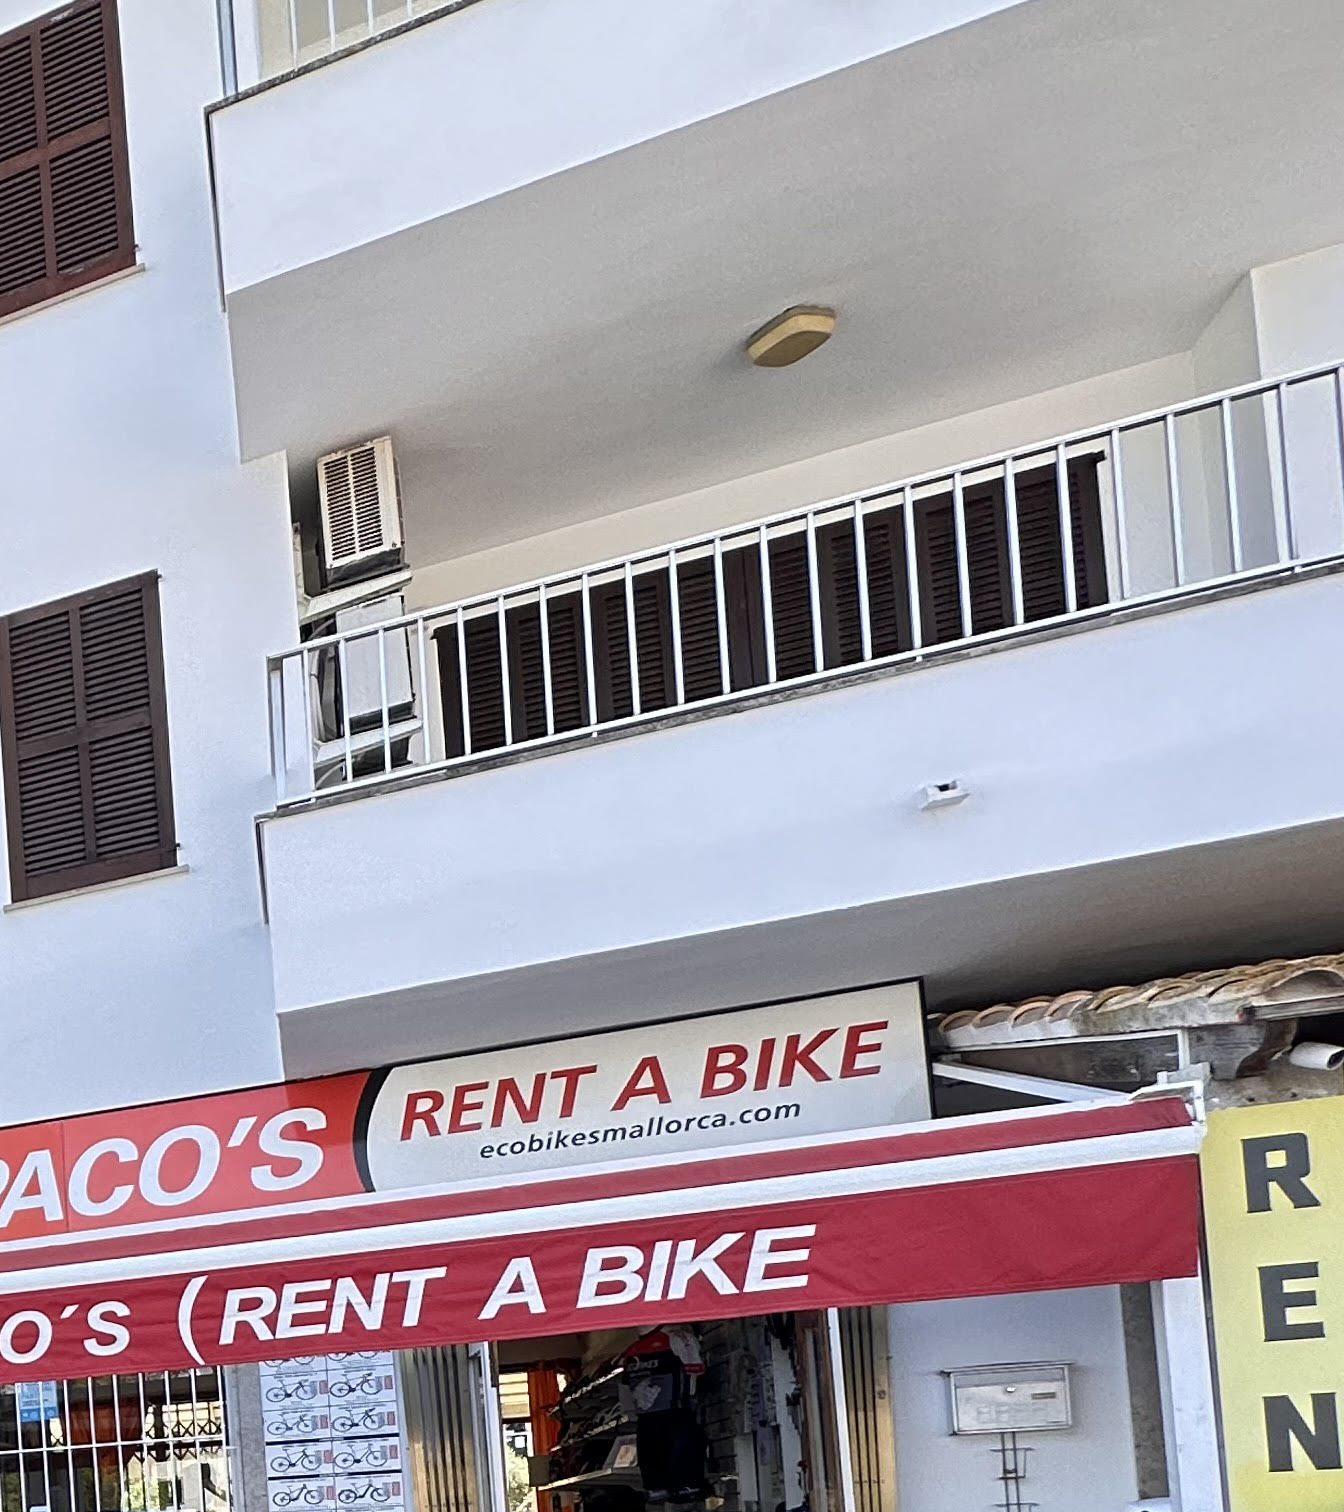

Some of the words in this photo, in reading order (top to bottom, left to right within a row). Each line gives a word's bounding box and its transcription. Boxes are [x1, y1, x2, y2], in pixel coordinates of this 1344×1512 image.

[400, 1064, 598, 1141] RENT
[611, 1055, 671, 1112] A
[699, 1020, 889, 1098] BIKE
[479, 1102, 801, 1159] ecobikesmallorca.com
[477, 1256, 546, 1320] A
[576, 1224, 817, 1309] BIKE
